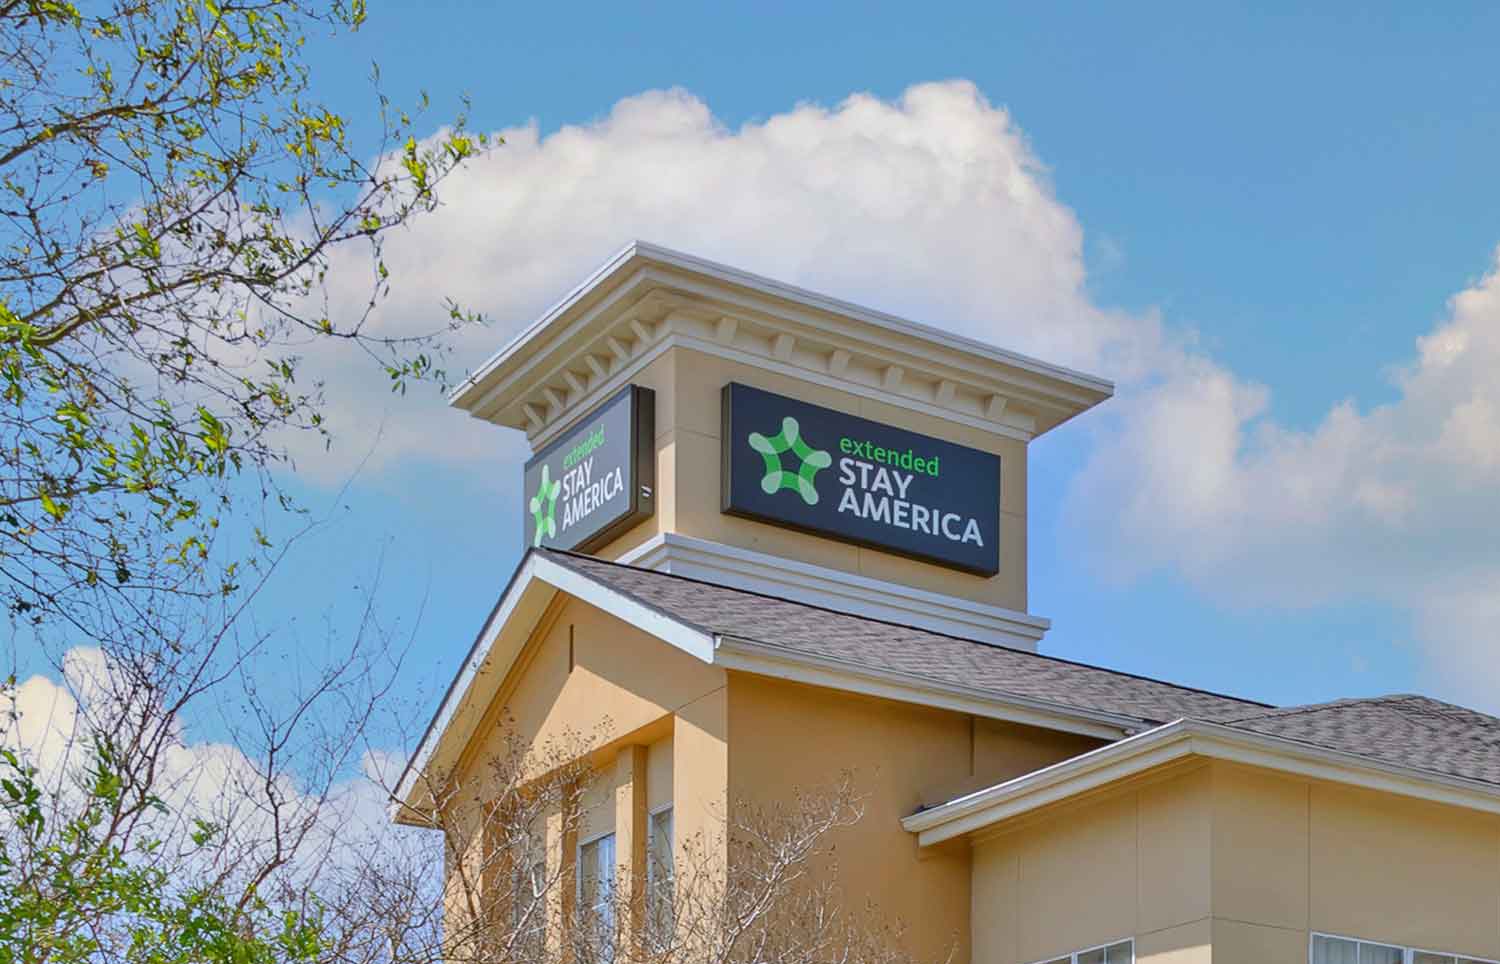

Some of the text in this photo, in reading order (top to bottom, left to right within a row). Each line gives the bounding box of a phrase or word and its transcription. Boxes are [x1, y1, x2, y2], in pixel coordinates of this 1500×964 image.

[563, 456, 593, 502] STAY
[839, 437, 940, 477] extended
[839, 457, 914, 499] STAY
[562, 466, 624, 532] AMERICA
[838, 487, 984, 547] AMERICA
